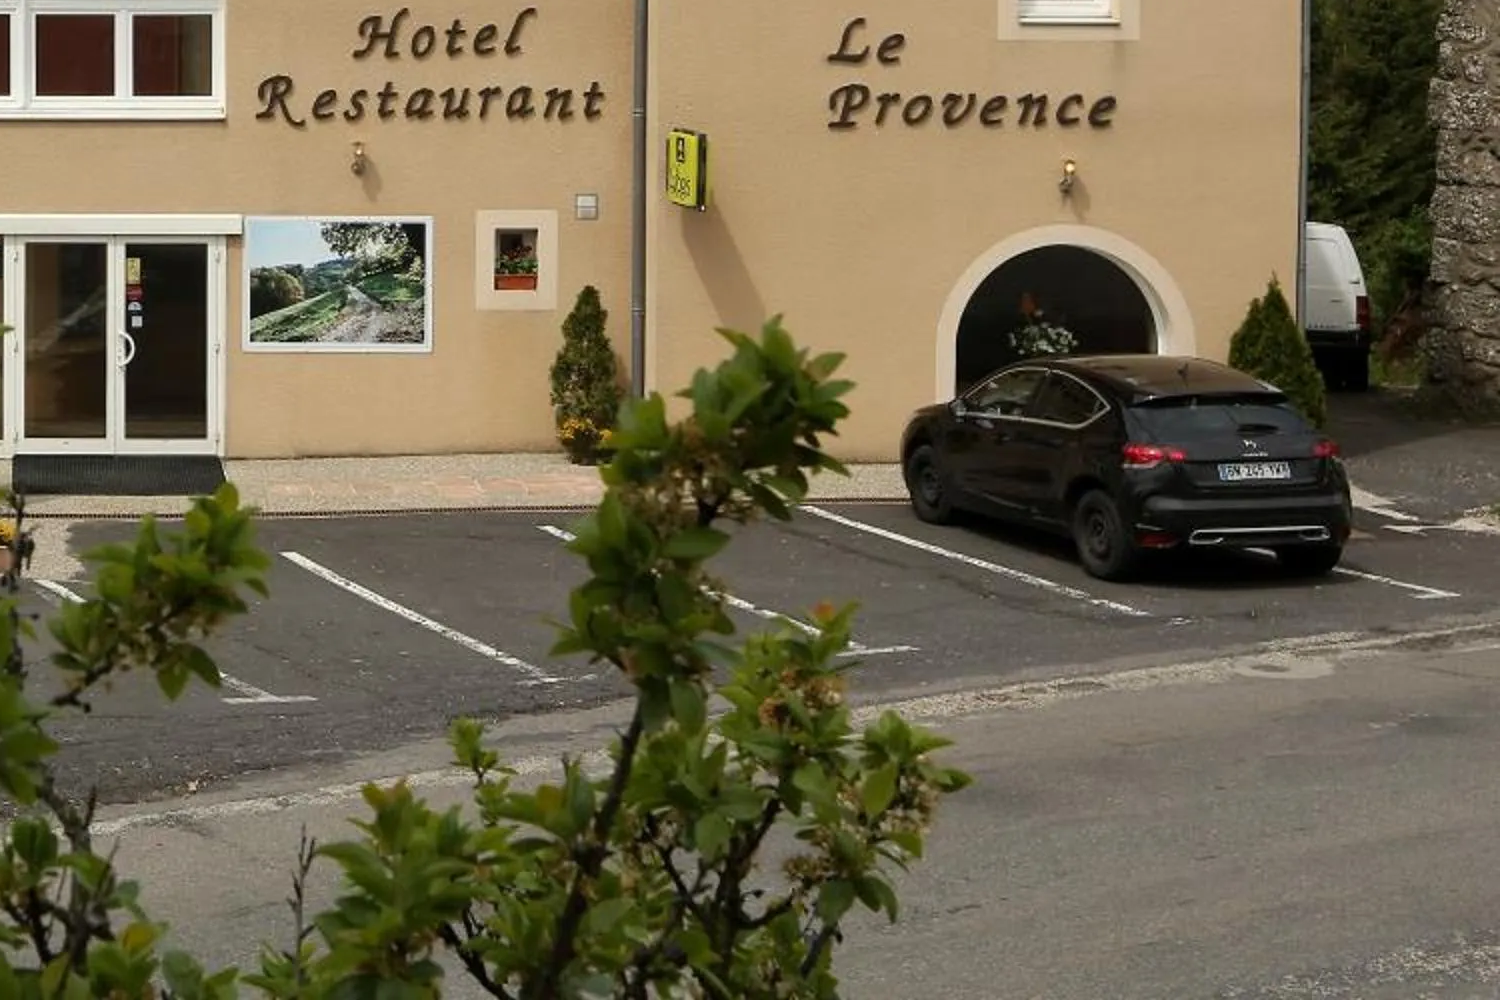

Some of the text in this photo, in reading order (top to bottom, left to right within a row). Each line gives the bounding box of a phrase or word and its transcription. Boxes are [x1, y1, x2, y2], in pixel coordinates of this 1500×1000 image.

[352, 7, 538, 60] Hotel
[827, 17, 905, 63] Le
[255, 74, 604, 128] Restaurant
[827, 83, 1118, 129] Provence
